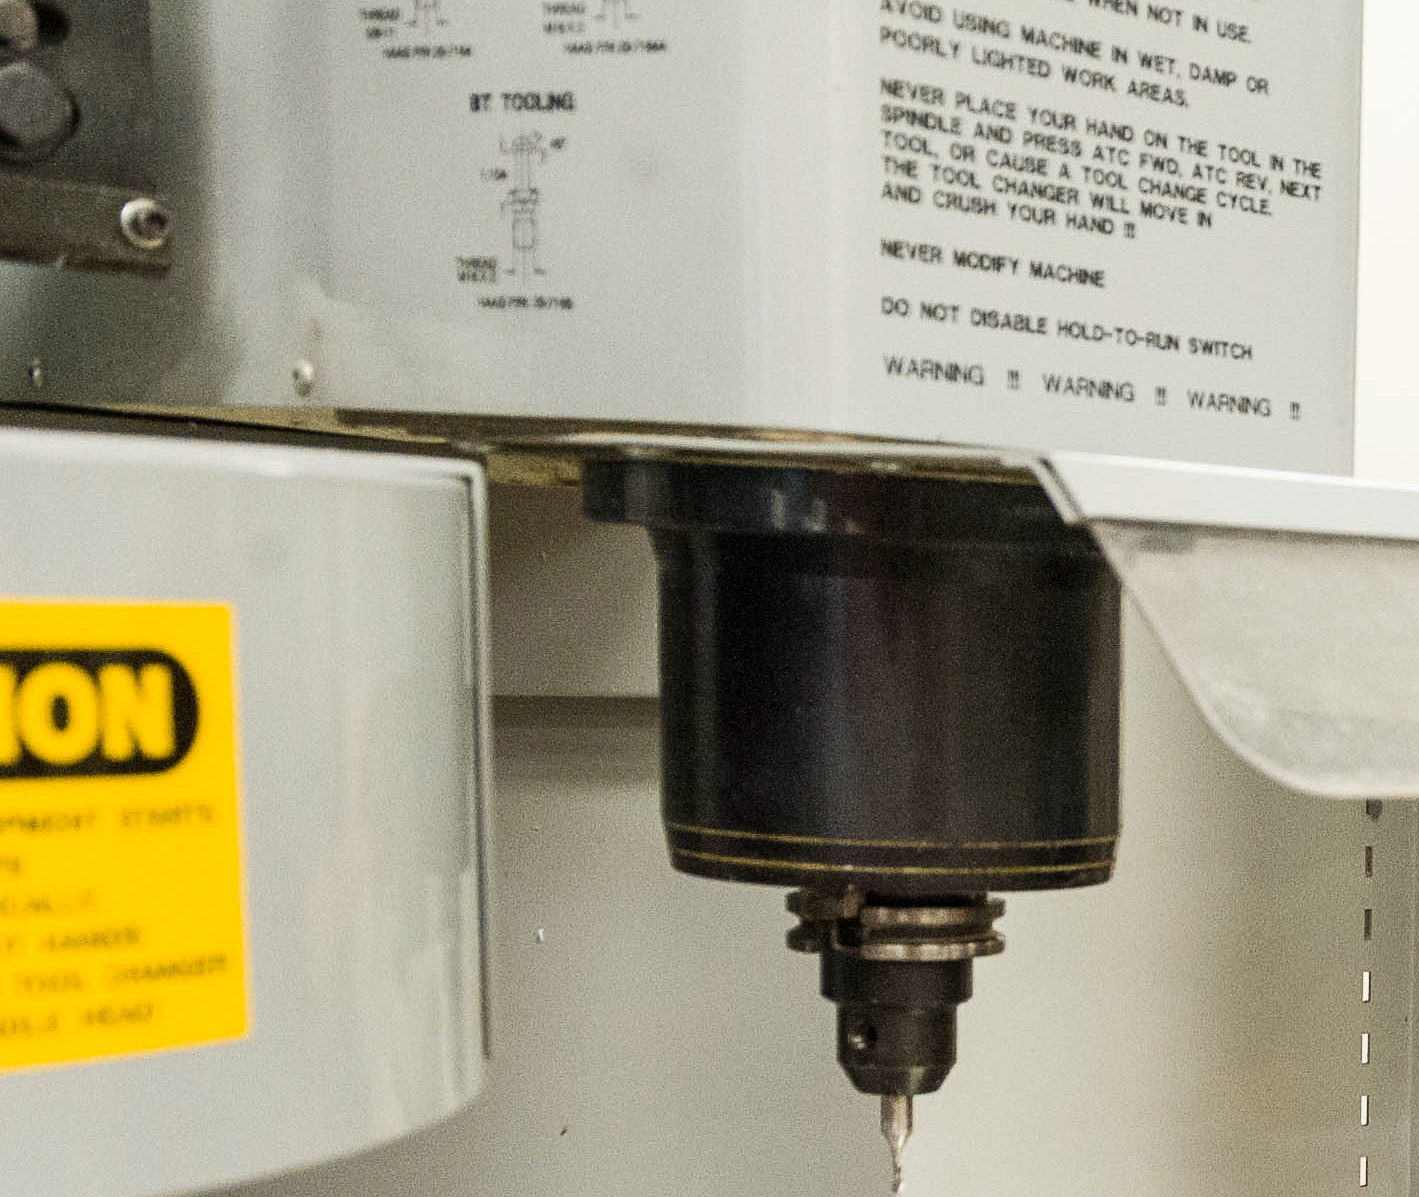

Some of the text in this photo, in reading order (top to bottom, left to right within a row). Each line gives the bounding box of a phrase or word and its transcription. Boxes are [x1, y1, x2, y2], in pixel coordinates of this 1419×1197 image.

[880, 0, 942, 24] AVOID
[953, 9, 1010, 39] USING
[1021, 24, 1102, 60] MACHINE
[1111, 45, 1129, 65] IN
[1189, 61, 1238, 88] DAMP
[1246, 75, 1270, 97] OR
[1147, 5, 1183, 27] NOT
[879, 25, 961, 59] POORLY
[972, 45, 1051, 79] LIGHTED
[1062, 63, 1117, 93] WORK
[501, 91, 576, 114] TOOLING
[880, 77, 1323, 181] NEVER PLACE YOUR HAND ON THE TOOL IN THE
[880, 103, 962, 137] SPINDLE
[973, 121, 1014, 145] AND
[1022, 130, 1083, 158] PRESS
[1092, 144, 1130, 167] ATC
[1191, 163, 1227, 185] ATC
[1279, 179, 1323, 201] NEXT
[949, 142, 976, 164] OR
[986, 148, 1049, 178] CAUSE
[1058, 161, 1072, 181] A
[1081, 165, 1129, 191] TOOL
[1138, 176, 1209, 206] CHANGE
[881, 154, 1213, 229] THE TOOL CHANGER WILL MOVE IN
[881, 180, 922, 205] AND
[932, 188, 997, 216] CRUSH
[1007, 202, 1057, 227] YOUR
[1065, 211, 1115, 236] HAND
[880, 238, 1106, 289] NEVER MODIFY MACHINE
[880, 295, 1254, 361] DO NOT DISABLE HOLD-TO-RUN SWITCH
[882, 354, 986, 388] WARNING
[1042, 372, 1136, 404] WARNING
[1185, 388, 1273, 419] WARNING
